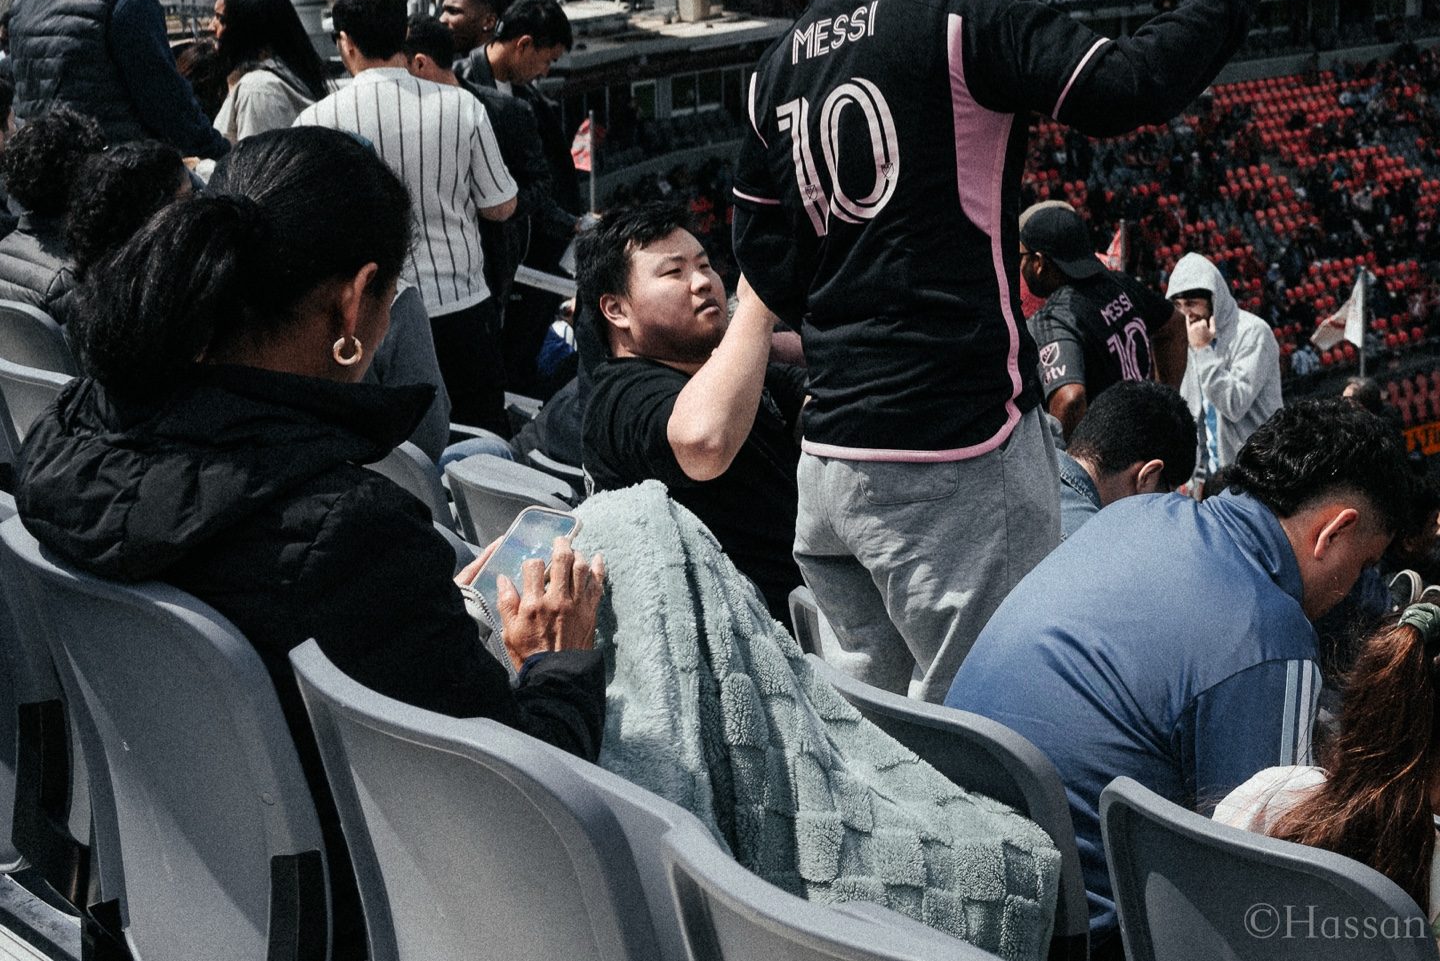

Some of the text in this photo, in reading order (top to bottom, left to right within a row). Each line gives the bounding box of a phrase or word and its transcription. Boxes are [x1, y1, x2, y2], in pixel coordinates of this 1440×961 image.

[792, 0, 879, 65] MESSI
[775, 77, 901, 238] 10
[1100, 291, 1134, 327] MESSI
[1106, 316, 1152, 383] 10
